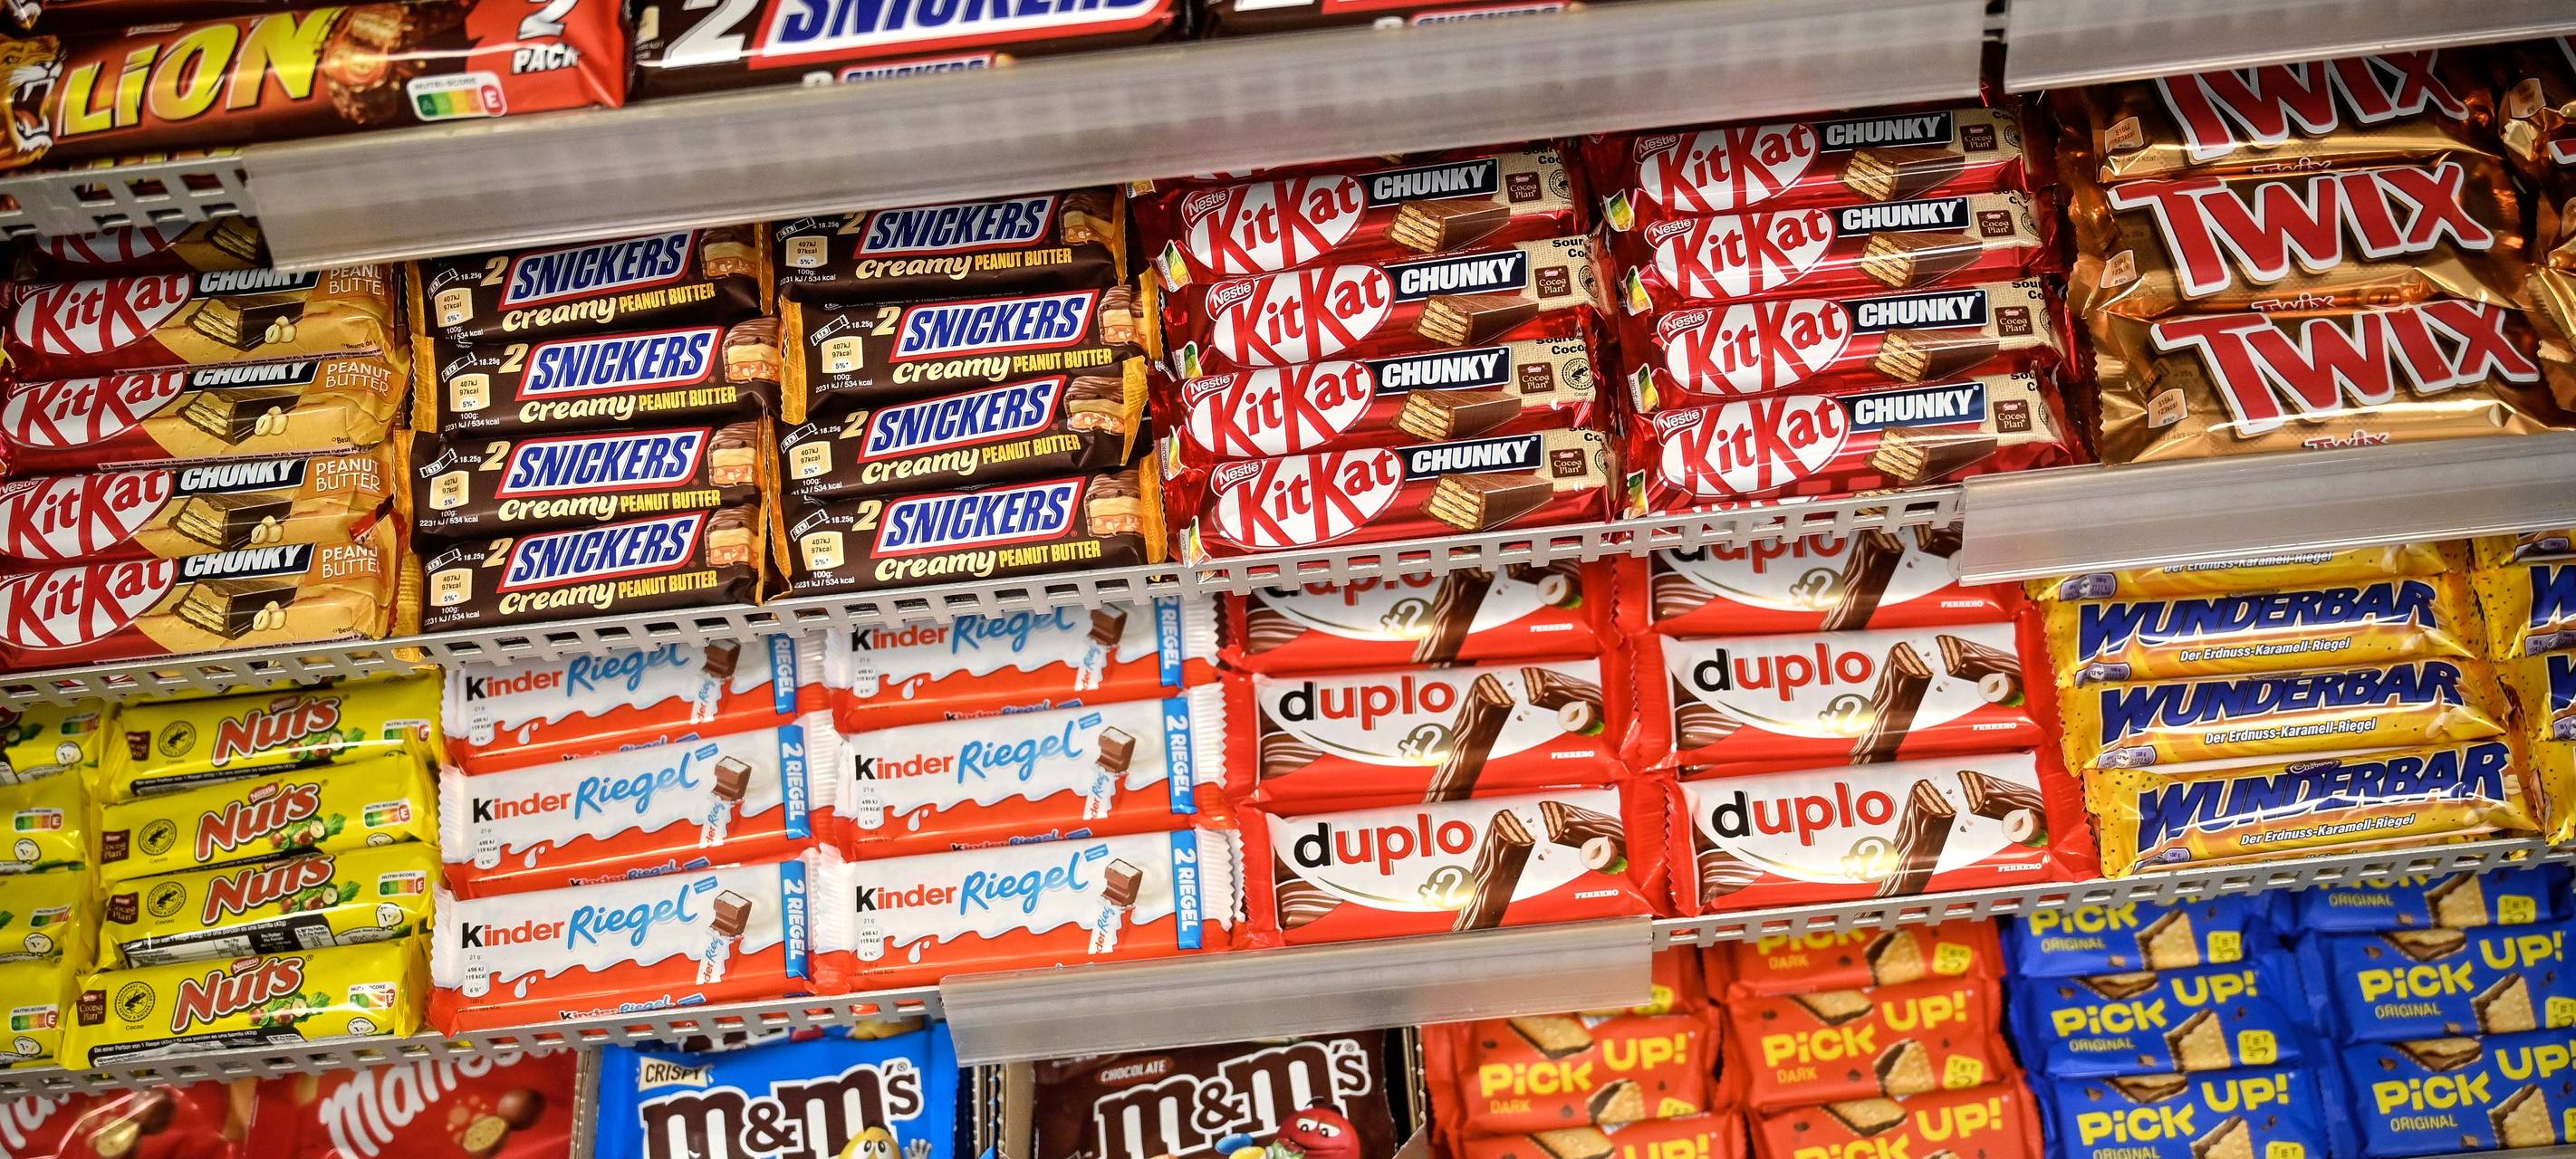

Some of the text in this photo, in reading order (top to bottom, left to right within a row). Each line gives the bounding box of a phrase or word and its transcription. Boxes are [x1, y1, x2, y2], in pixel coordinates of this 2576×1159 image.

[519, 0, 581, 40] 2
[511, 43, 581, 74] PACK
[1659, 116, 1941, 212] KitKat CHUNKY
[868, 198, 1048, 252] SNICKERS
[1209, 164, 1487, 273] KitKat CHUNKY
[2107, 161, 2494, 297] TWIX
[510, 234, 688, 302] SNICKERS
[1672, 201, 1958, 299] KitKat CHUNKY
[620, 289, 669, 313] PEANUT
[670, 283, 716, 305] BUTTER
[1233, 256, 1516, 360] KitKat CHUNKY
[851, 321, 873, 329] 18.25g
[870, 307, 903, 337] 2
[901, 297, 1089, 352] SNICKERS
[2000, 317, 2028, 327] Cocoa
[2004, 324, 2025, 334] Plan
[479, 358, 500, 366] 18.25g
[499, 333, 711, 391] 2 SNICKERS
[831, 350, 852, 359] 97kcal
[1014, 353, 1062, 373] PEANUT
[1064, 348, 1112, 368] BUTTER
[1685, 294, 1975, 393] KitKat CHUNKY
[325, 376, 389, 396] BUTTER
[327, 362, 392, 380] PEANUT
[1522, 374, 1550, 384] Cocoa
[1526, 381, 1547, 390] Plan
[2151, 299, 2540, 439] TWIX
[17, 362, 304, 445] KitKat CHUNKY
[639, 392, 688, 412] PEANUT
[690, 387, 737, 407] BUTTER
[870, 383, 1050, 453] SNICKERS
[1209, 353, 1500, 456] KitKat CHUNKY
[459, 455, 482, 464] 18.25g
[479, 435, 697, 489] 2 SNICKERS
[982, 440, 1031, 466] PEANUT
[1033, 434, 1081, 460] BUTTER
[1554, 460, 1581, 469] Cocoa
[1680, 394, 1974, 495] KitKat CHUNKY
[315, 458, 380, 476] PEANUT
[315, 474, 381, 493] BUTTER
[1560, 467, 1581, 476] Plan
[7, 459, 294, 560] KitKat CHUNKY
[620, 493, 670, 513] PEANUT
[672, 490, 722, 509] BUTTER
[1238, 441, 1532, 545] KitKat CHUNKY
[831, 515, 854, 524] 18.25g
[852, 486, 1076, 549] 2 SNICKERS
[511, 520, 692, 582] SNICKERS
[811, 545, 832, 554] 97kcal
[812, 537, 831, 545] 407kJ
[999, 547, 1048, 569] PEANUT
[1051, 540, 1101, 563] BUTTER
[322, 558, 381, 579] BUTTE
[618, 577, 668, 599] PEANUT
[669, 571, 718, 593] BUTTER
[6, 546, 301, 648] KitKat CHUNKY
[1940, 599, 1985, 608] FERRERO
[1530, 623, 1573, 632] FERRERO
[2078, 580, 2437, 663] WUNDERBAR
[2180, 637, 2351, 662] Der Erdnuss-Karamell-Riegel
[1693, 643, 1875, 702] duplo
[1279, 675, 1458, 731] duplo
[2100, 661, 2465, 748] WUNDERBAR
[212, 696, 341, 767] Nuts
[2204, 718, 2377, 744] Der Erdnuss-Karamell-Riegel
[957, 720, 1083, 784] Riegel
[1169, 733, 1189, 797] RIEGEL
[1551, 750, 1594, 759] FERRERO
[574, 750, 700, 820] Riegel
[786, 760, 805, 821] RIEGEL
[2137, 742, 2509, 855] WUNDERBAR
[196, 783, 321, 862] Nuts
[1711, 781, 1896, 847] duplo
[2240, 814, 2416, 846] Der Erdnuss-Karamell-Riegel
[1294, 813, 1477, 876] duplo
[960, 851, 1089, 915] Riegel
[1997, 862, 2043, 873] FERRERO
[201, 854, 336, 925] Nuts
[1174, 848, 1200, 932] 2 RIEGEL
[1574, 889, 1620, 899] FERRERO
[568, 883, 697, 951] Riegel
[784, 879, 808, 961] 2 RIEGEL
[2479, 931, 2563, 971] UP!
[172, 956, 304, 1032] Nuts
[2170, 971, 2258, 1007] UP!
[1881, 991, 1966, 1032] UP!
[2375, 1003, 2442, 1020] ORIGINAL
[1602, 1033, 1687, 1071] UP!
[2069, 1038, 2135, 1053] ORIGINAL
[645, 1063, 701, 1083] CRISPY
[1101, 1058, 1167, 1083] CHOCOLATE
[1776, 1068, 1817, 1085] DARK
[1490, 1100, 1532, 1115] DARK
[2201, 1073, 2290, 1113] UP!
[1916, 1097, 2003, 1142] UP!
[2390, 1115, 2459, 1133] ORIGINAL
